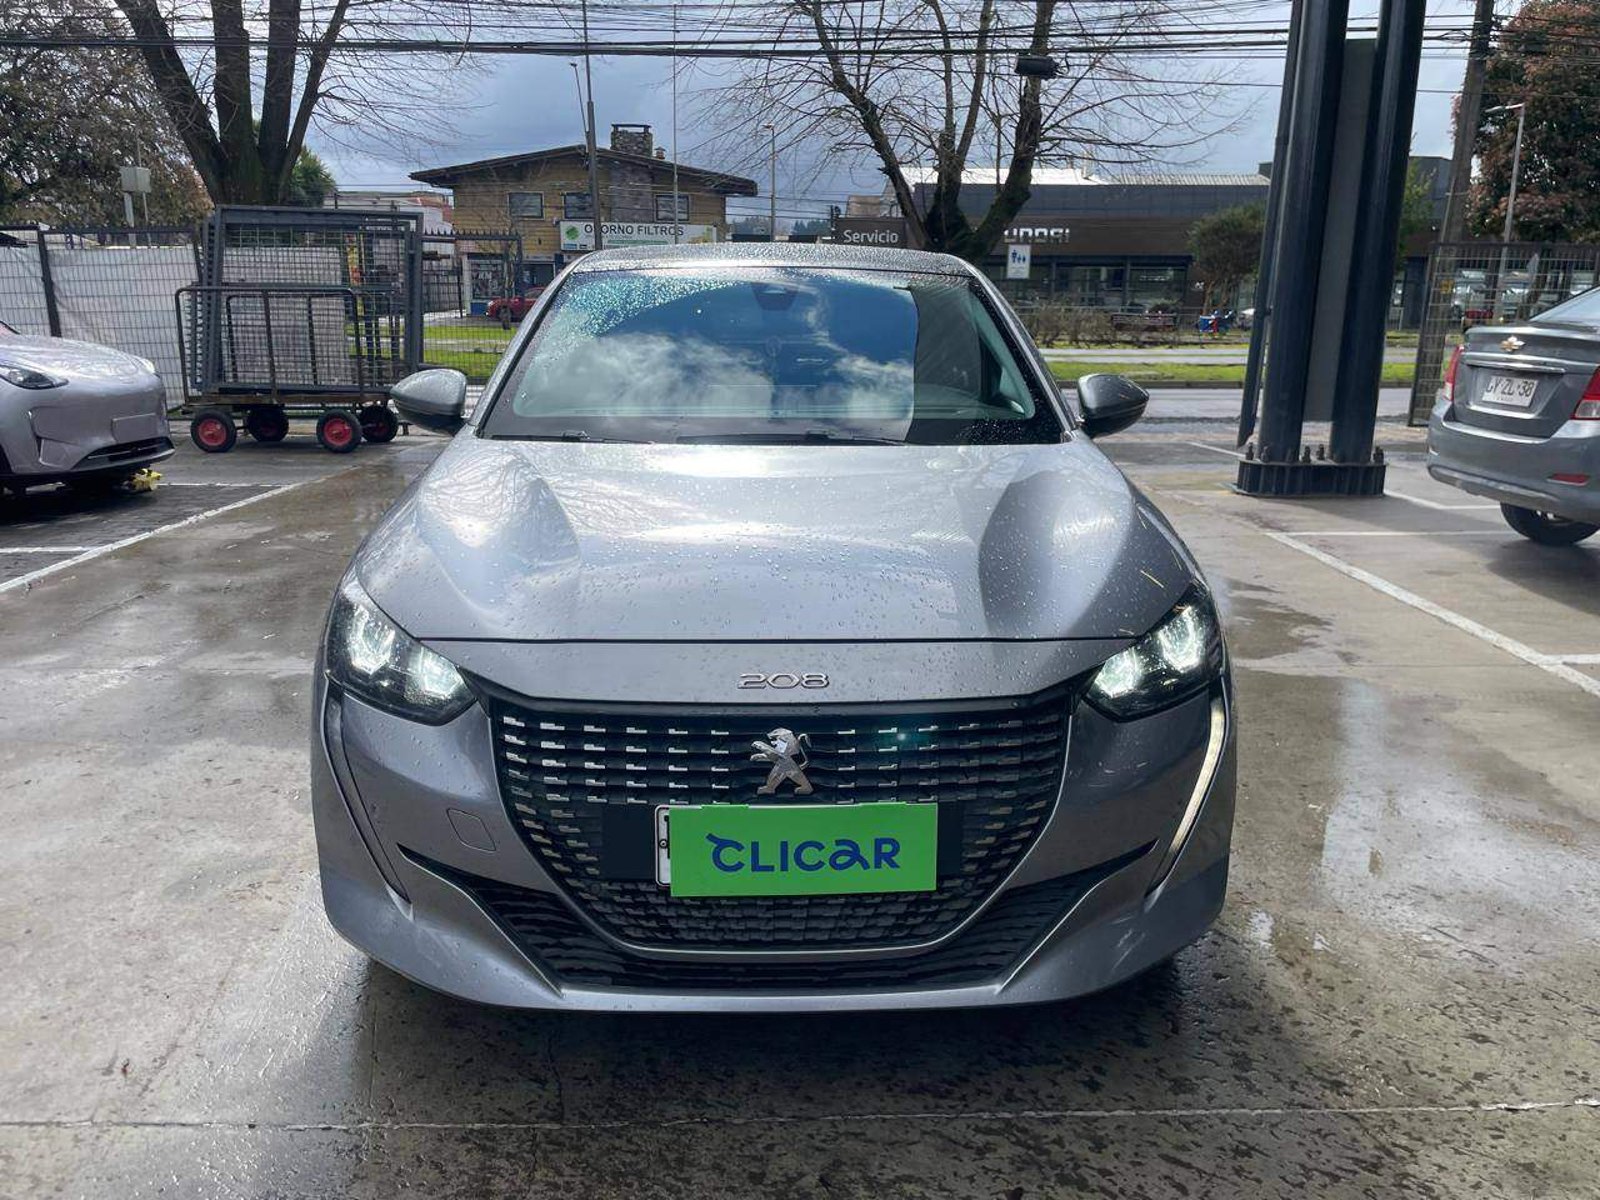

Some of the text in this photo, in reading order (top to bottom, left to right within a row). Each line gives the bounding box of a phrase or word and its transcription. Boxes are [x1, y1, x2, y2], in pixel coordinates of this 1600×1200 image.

[584, 223, 684, 236] OORNO FILTROS
[843, 229, 899, 244] Servicio
[737, 672, 831, 690] 208
